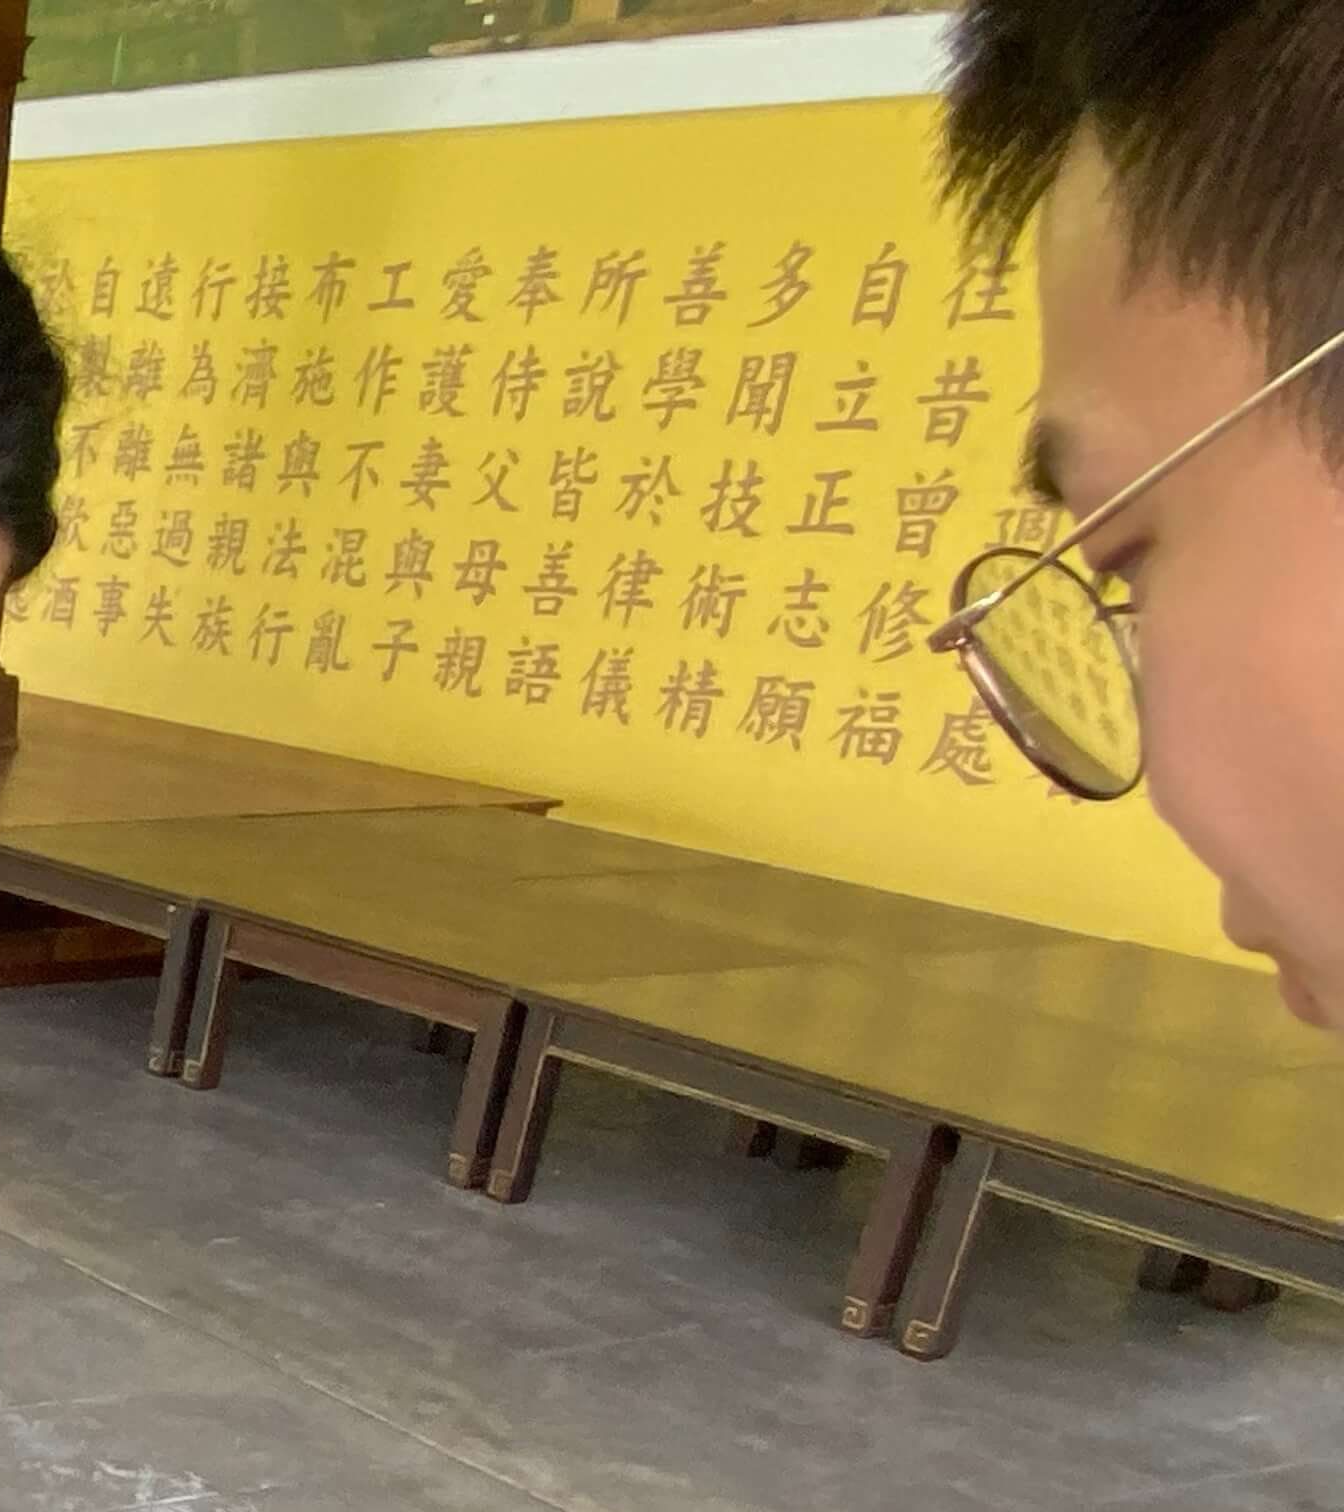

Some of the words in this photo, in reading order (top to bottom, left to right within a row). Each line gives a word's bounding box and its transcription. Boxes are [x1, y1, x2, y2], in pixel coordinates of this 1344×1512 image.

[139, 255, 237, 648] 行為無過失
[192, 253, 292, 656] 接濟諸親族
[248, 251, 357, 668] 布施與法行
[305, 260, 415, 674] 工作不混亂
[371, 246, 493, 682] 愛護妻與子
[433, 244, 564, 698] 奉侍父母親
[506, 248, 647, 705] 所說皆善語
[578, 241, 728, 726] 善學於律儀
[655, 239, 816, 739] 多聞技術精
[736, 241, 909, 753] 自立正志願
